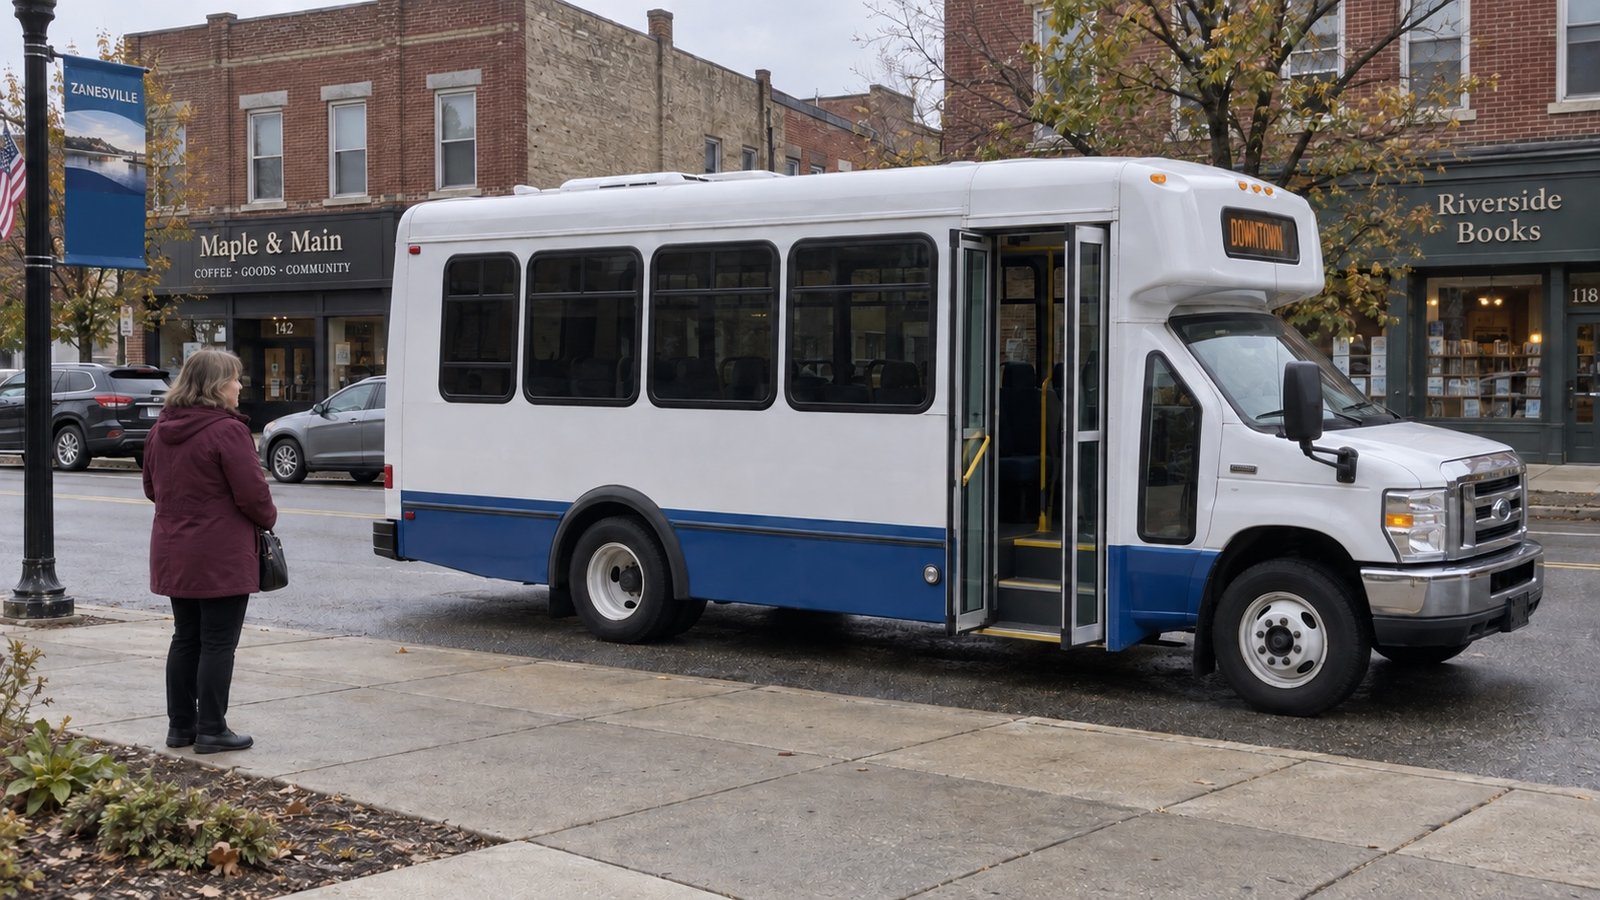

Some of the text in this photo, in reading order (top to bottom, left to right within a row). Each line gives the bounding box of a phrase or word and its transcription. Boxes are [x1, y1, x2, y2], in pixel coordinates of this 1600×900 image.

[70, 81, 139, 104] ZANESVILLE
[1437, 187, 1563, 216] Riverside
[1230, 218, 1284, 251] DOWNTOWN
[1456, 218, 1542, 244] Books
[199, 228, 343, 262] Maple & Main
[194, 262, 352, 279] COFFEE GOODS COMMUNITY
[1572, 287, 1599, 303] 118
[275, 321, 295, 336] 142
